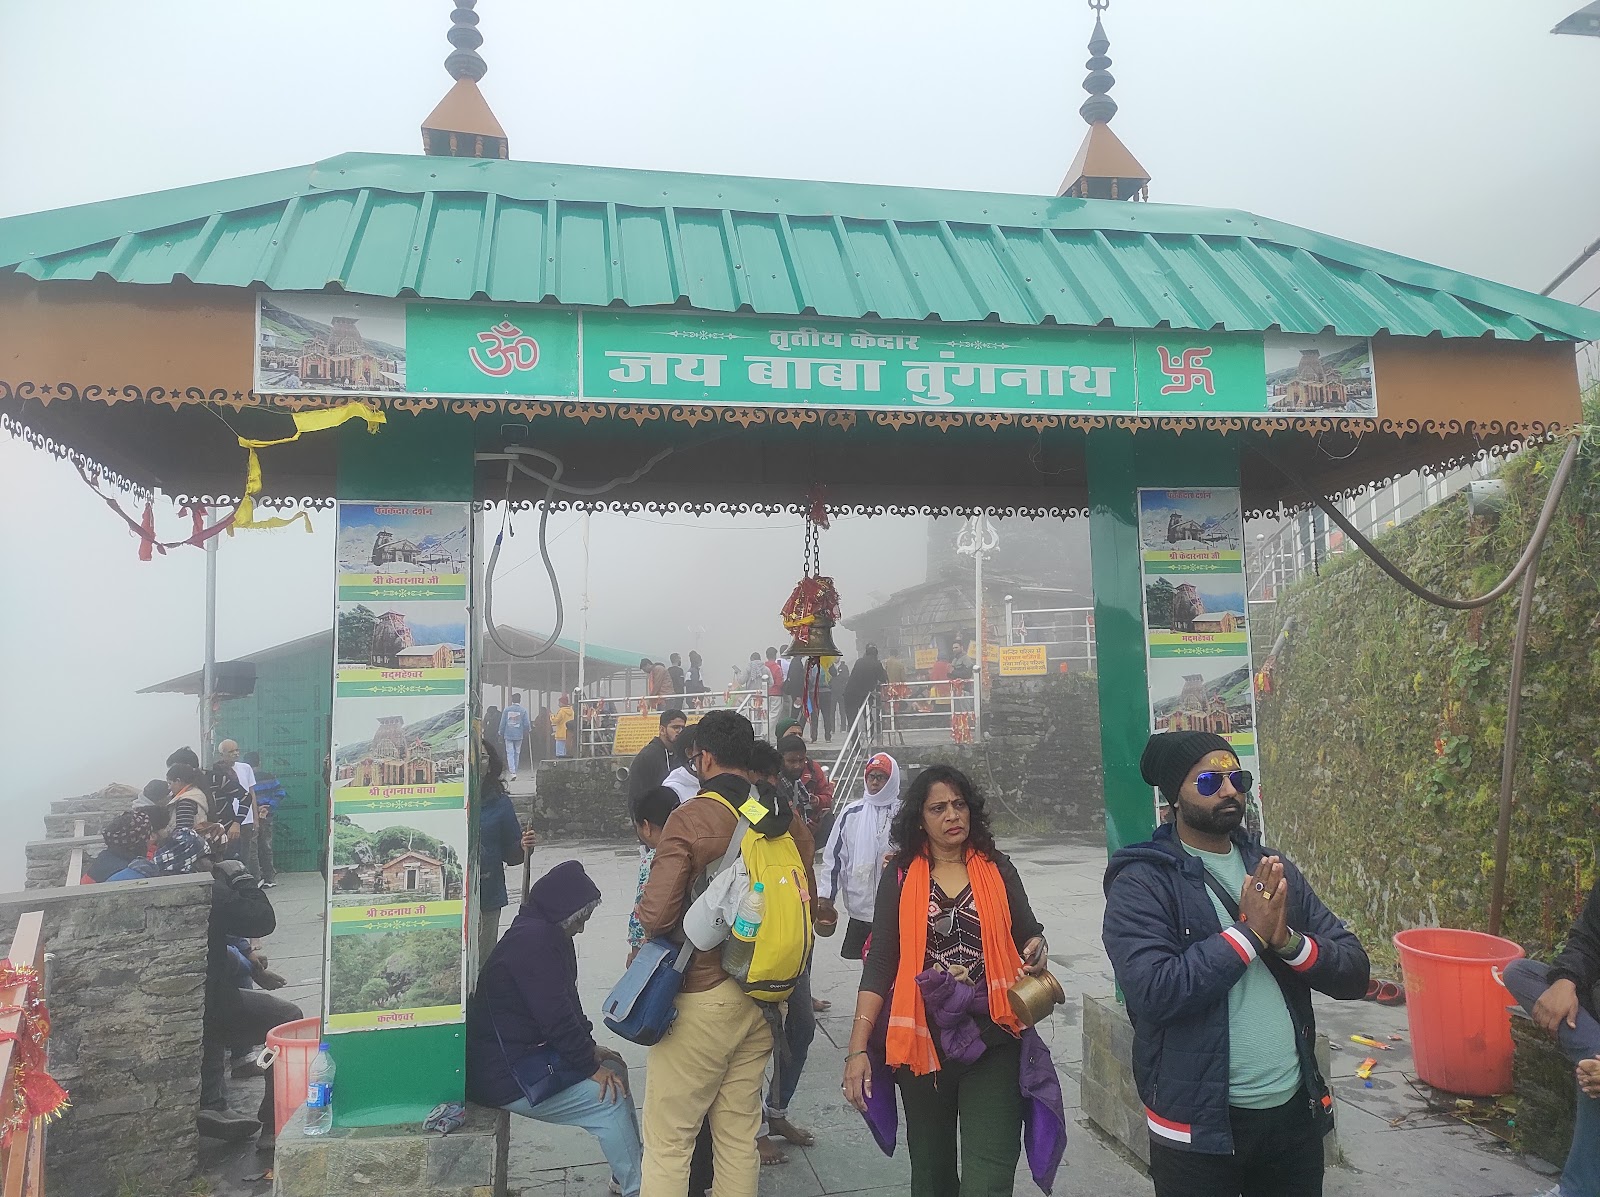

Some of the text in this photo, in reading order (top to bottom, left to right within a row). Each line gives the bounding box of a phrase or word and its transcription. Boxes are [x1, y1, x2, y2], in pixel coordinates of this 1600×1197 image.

[769, 327, 920, 351] तृतीय केदार
[605, 350, 1116, 405] जय बाबा तुंगनाथ
[412, 506, 434, 516] दर्शन
[1169, 551, 1220, 560] श्री केदारनाथ जी
[372, 575, 439, 585] श्री केदारनाथ जी
[380, 669, 423, 681] मद्महेश्वर
[368, 786, 380, 796] श्री
[366, 907, 378, 917] श्री
[414, 905, 427, 915] जी
[376, 1011, 415, 1023] कल्पेश्वर
